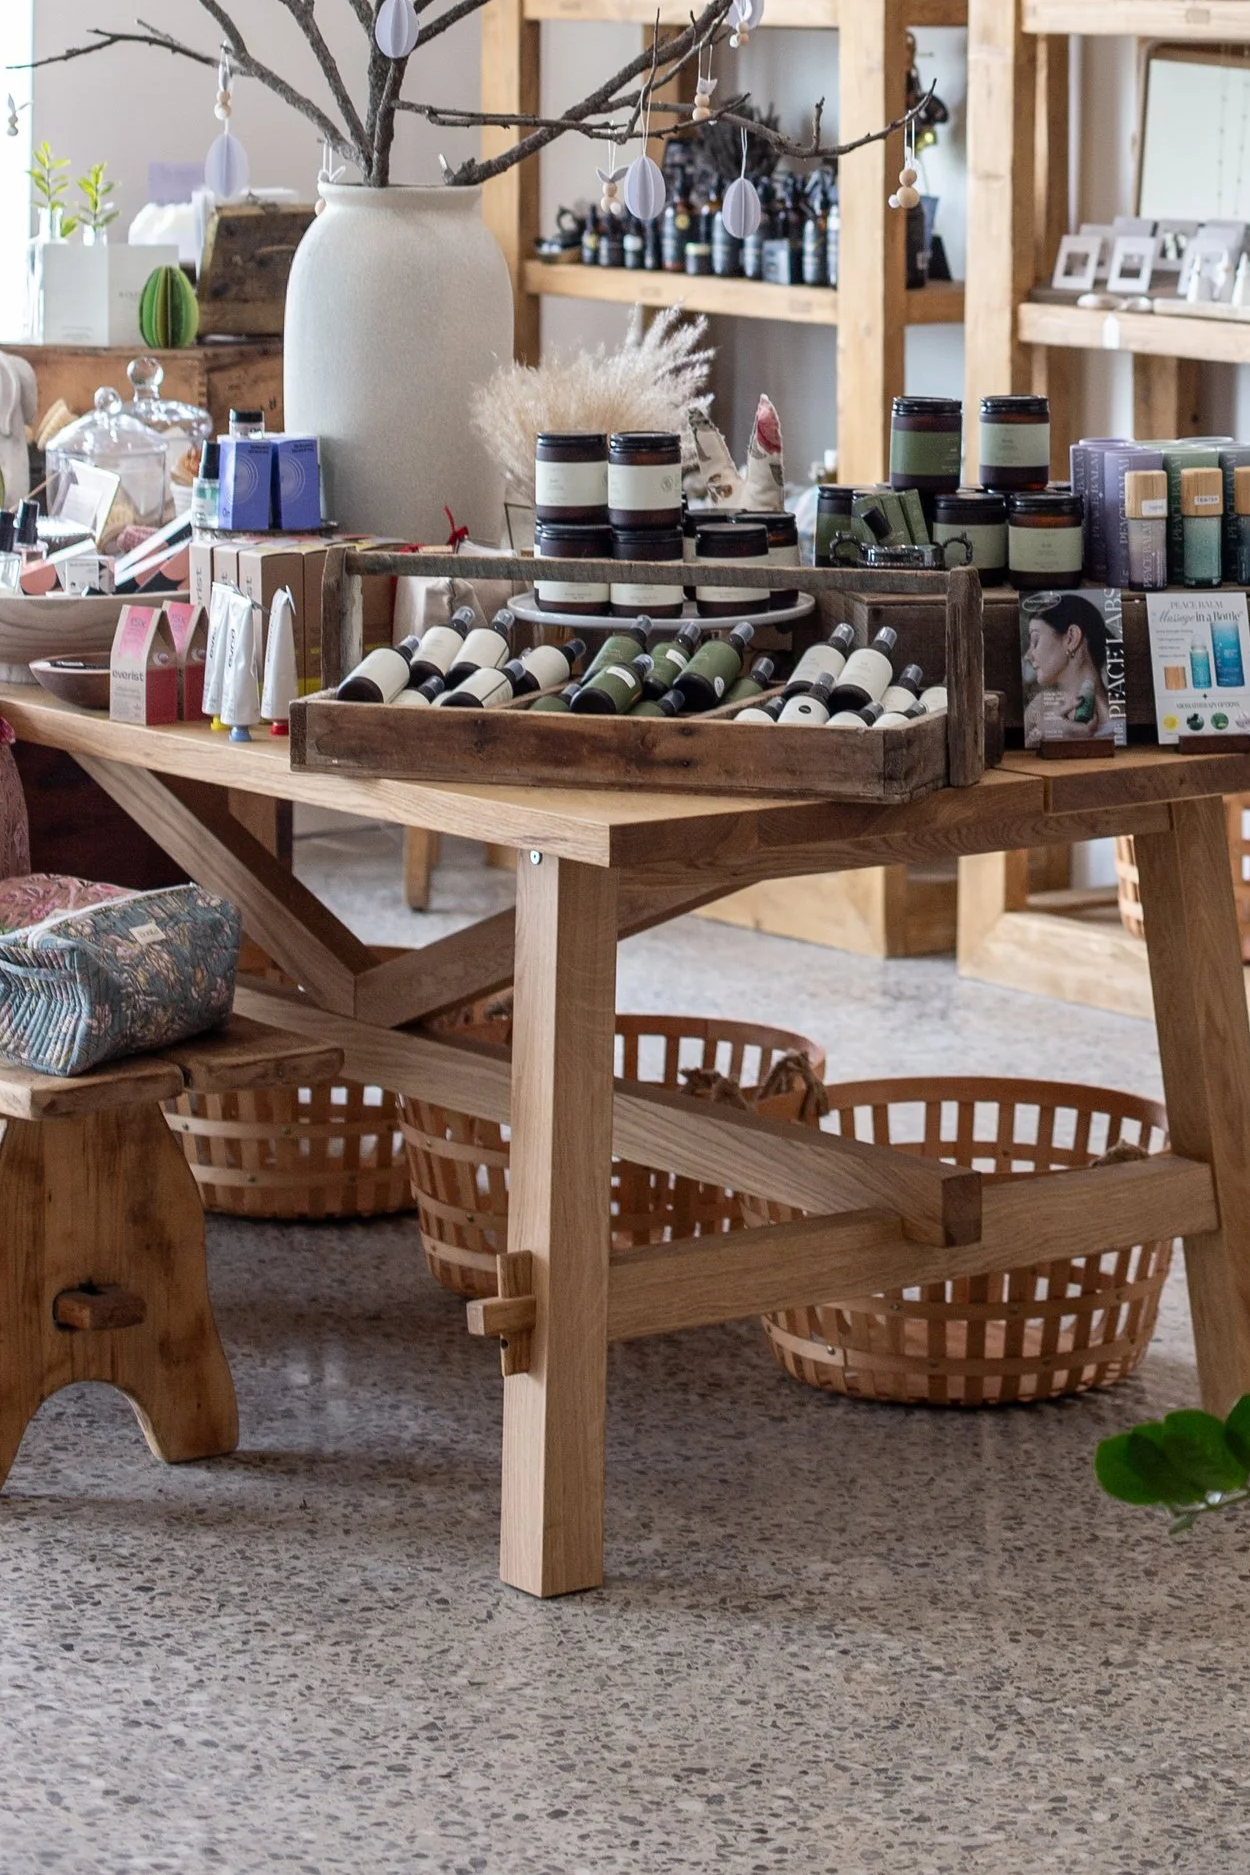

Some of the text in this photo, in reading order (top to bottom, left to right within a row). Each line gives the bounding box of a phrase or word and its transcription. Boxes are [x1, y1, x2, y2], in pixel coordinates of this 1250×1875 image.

[1090, 452, 1100, 493] BALM
[1142, 522, 1152, 588] PEACE BALM
[1103, 588, 1123, 643] LABS
[1170, 600, 1224, 609] PEACE BALM
[112, 670, 144, 683] everist
[1106, 648, 1127, 719] PEACE
